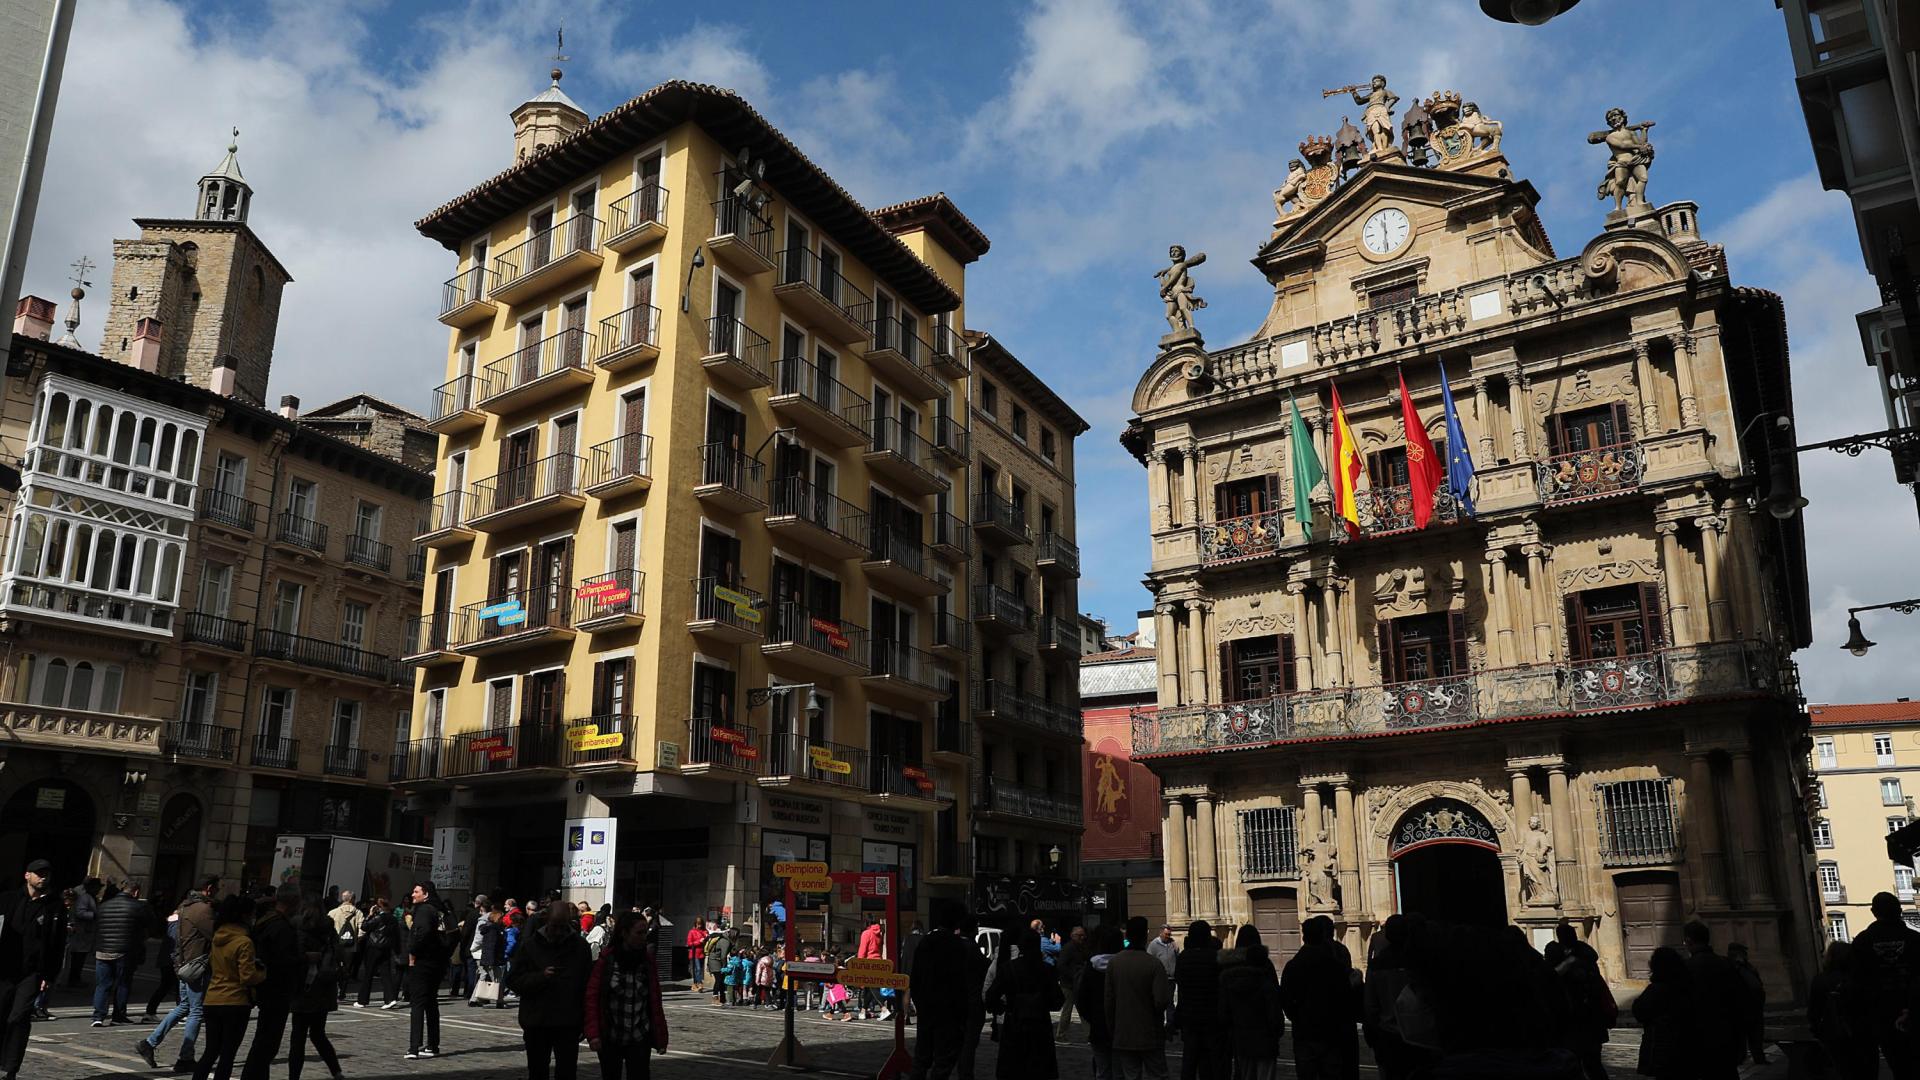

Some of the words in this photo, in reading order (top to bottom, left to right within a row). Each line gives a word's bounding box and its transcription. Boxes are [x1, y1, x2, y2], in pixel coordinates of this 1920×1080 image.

[586, 583, 615, 594] Pamplona
[719, 730, 745, 743] Pamplona
[477, 740, 502, 749] Pamplona
[776, 864, 785, 873] Di
[785, 864, 823, 876] Pamplona
[871, 963, 891, 972] esan
[841, 976, 854, 984] eta
[886, 977, 906, 988] egin!
